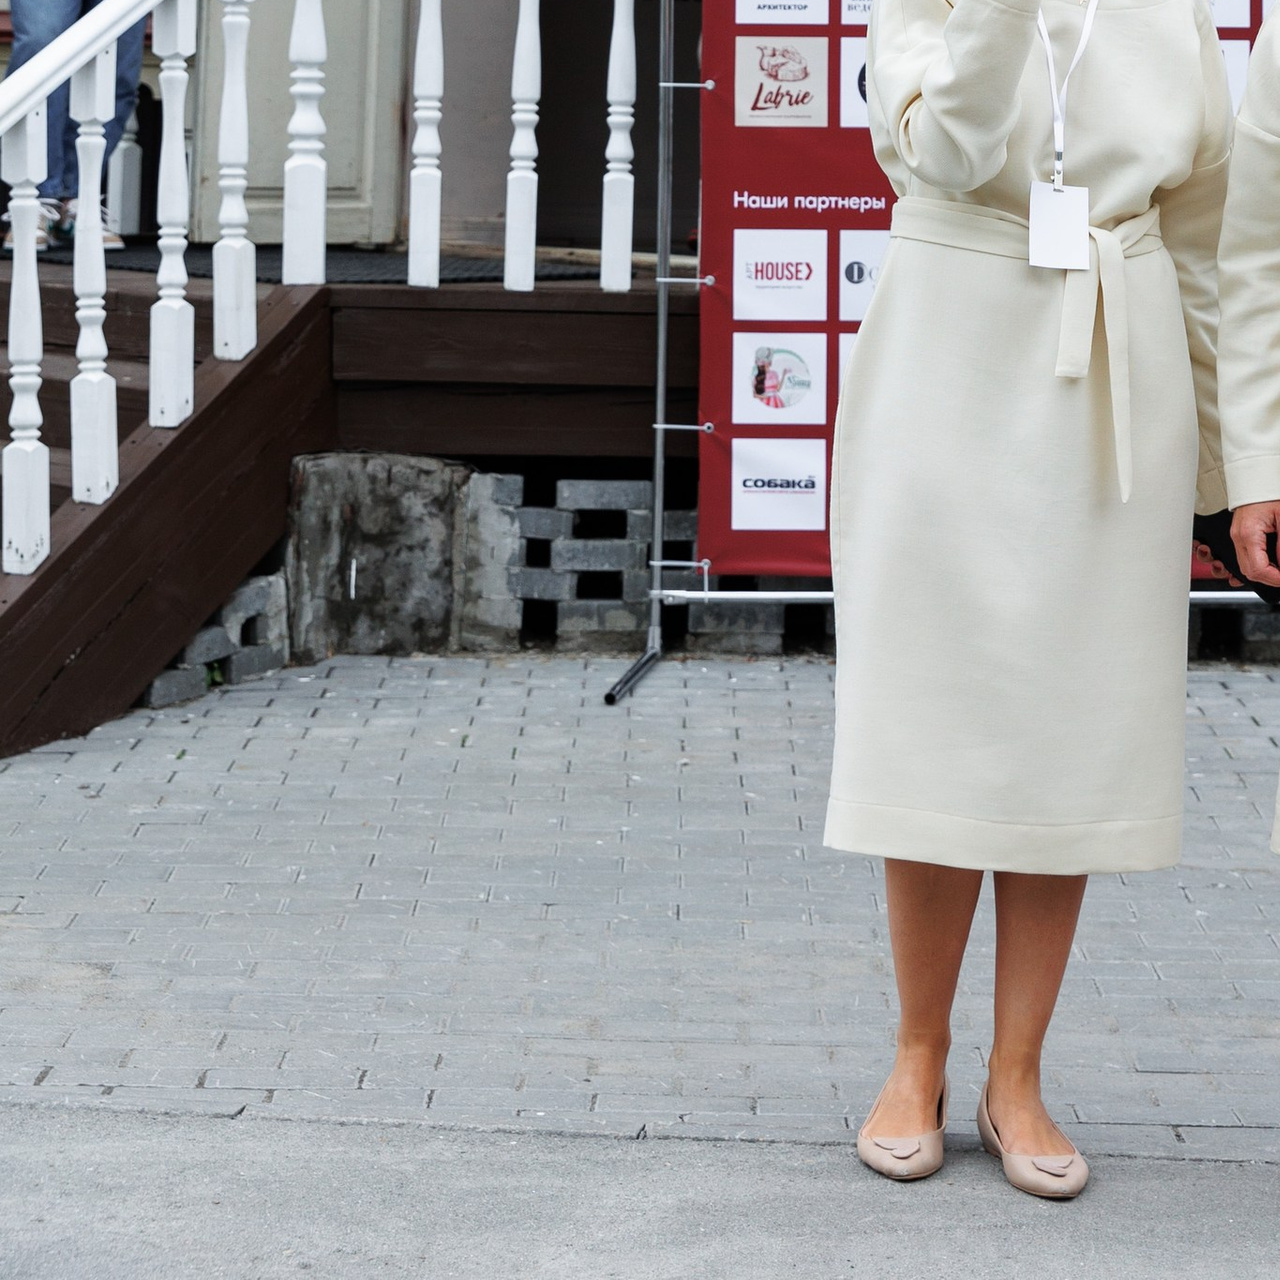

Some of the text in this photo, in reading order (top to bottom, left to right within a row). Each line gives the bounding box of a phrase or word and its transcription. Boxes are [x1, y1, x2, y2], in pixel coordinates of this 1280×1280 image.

[751, 82, 814, 111] Labrie
[733, 191, 886, 213] Наши партнеры
[755, 262, 803, 280] HOUSE
